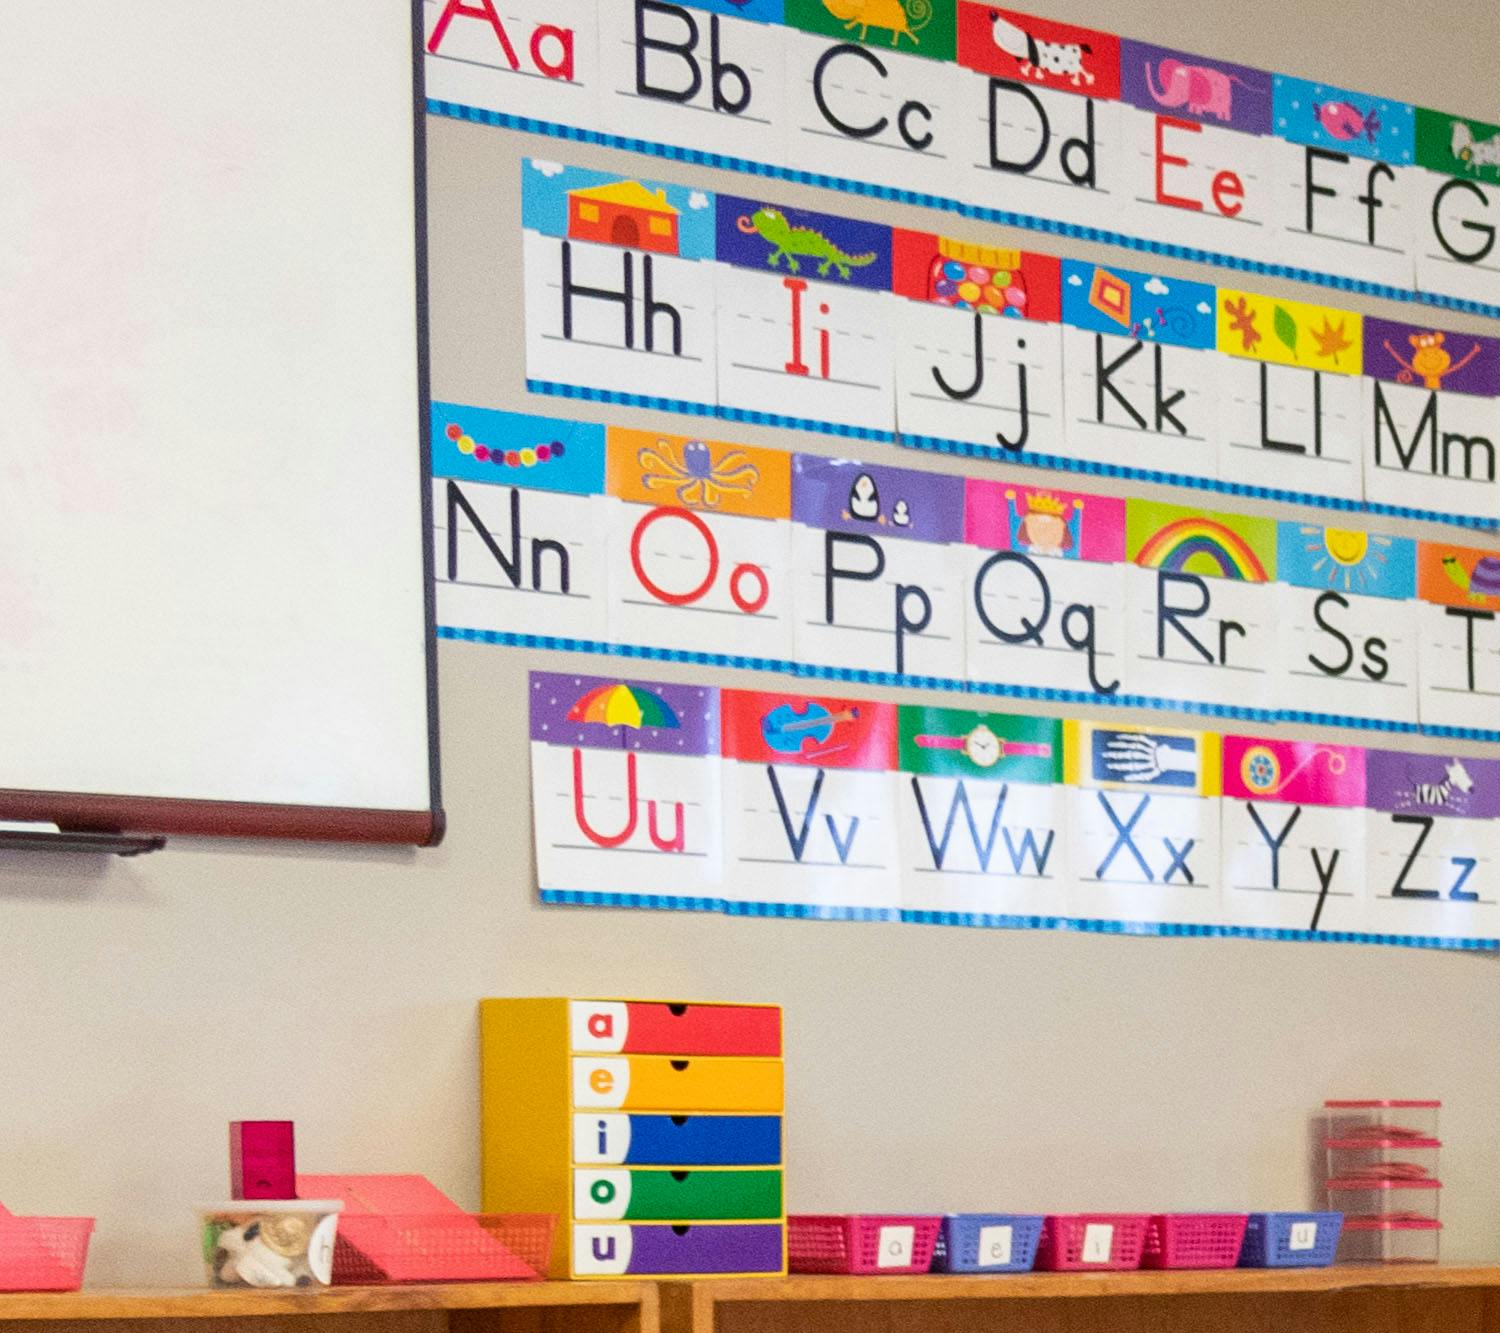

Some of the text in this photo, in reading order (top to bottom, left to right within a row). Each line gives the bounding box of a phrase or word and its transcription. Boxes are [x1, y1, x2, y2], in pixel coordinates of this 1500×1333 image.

[426, 0, 577, 82] Aa
[634, 0, 752, 117] Bb
[813, 43, 935, 151] Cc
[986, 76, 1096, 189] Dd
[1153, 116, 1246, 218] Ee
[1304, 147, 1394, 247] Ff
[561, 239, 1497, 484] Hh Ii Jj Kk Ll Mm
[445, 478, 571, 596] Nn
[630, 505, 770, 616] Oo
[823, 533, 933, 674] Pp
[973, 552, 1120, 694] Qq
[1157, 572, 1246, 667] Rr
[1307, 590, 1390, 682] Ss
[571, 747, 1479, 933] Uu Vv Ww Xx Yy Zz
[587, 1011, 614, 1038] a
[588, 1065, 616, 1093] e
[597, 1119, 609, 1155] i
[590, 1177, 616, 1204] o
[592, 1234, 617, 1261] u
